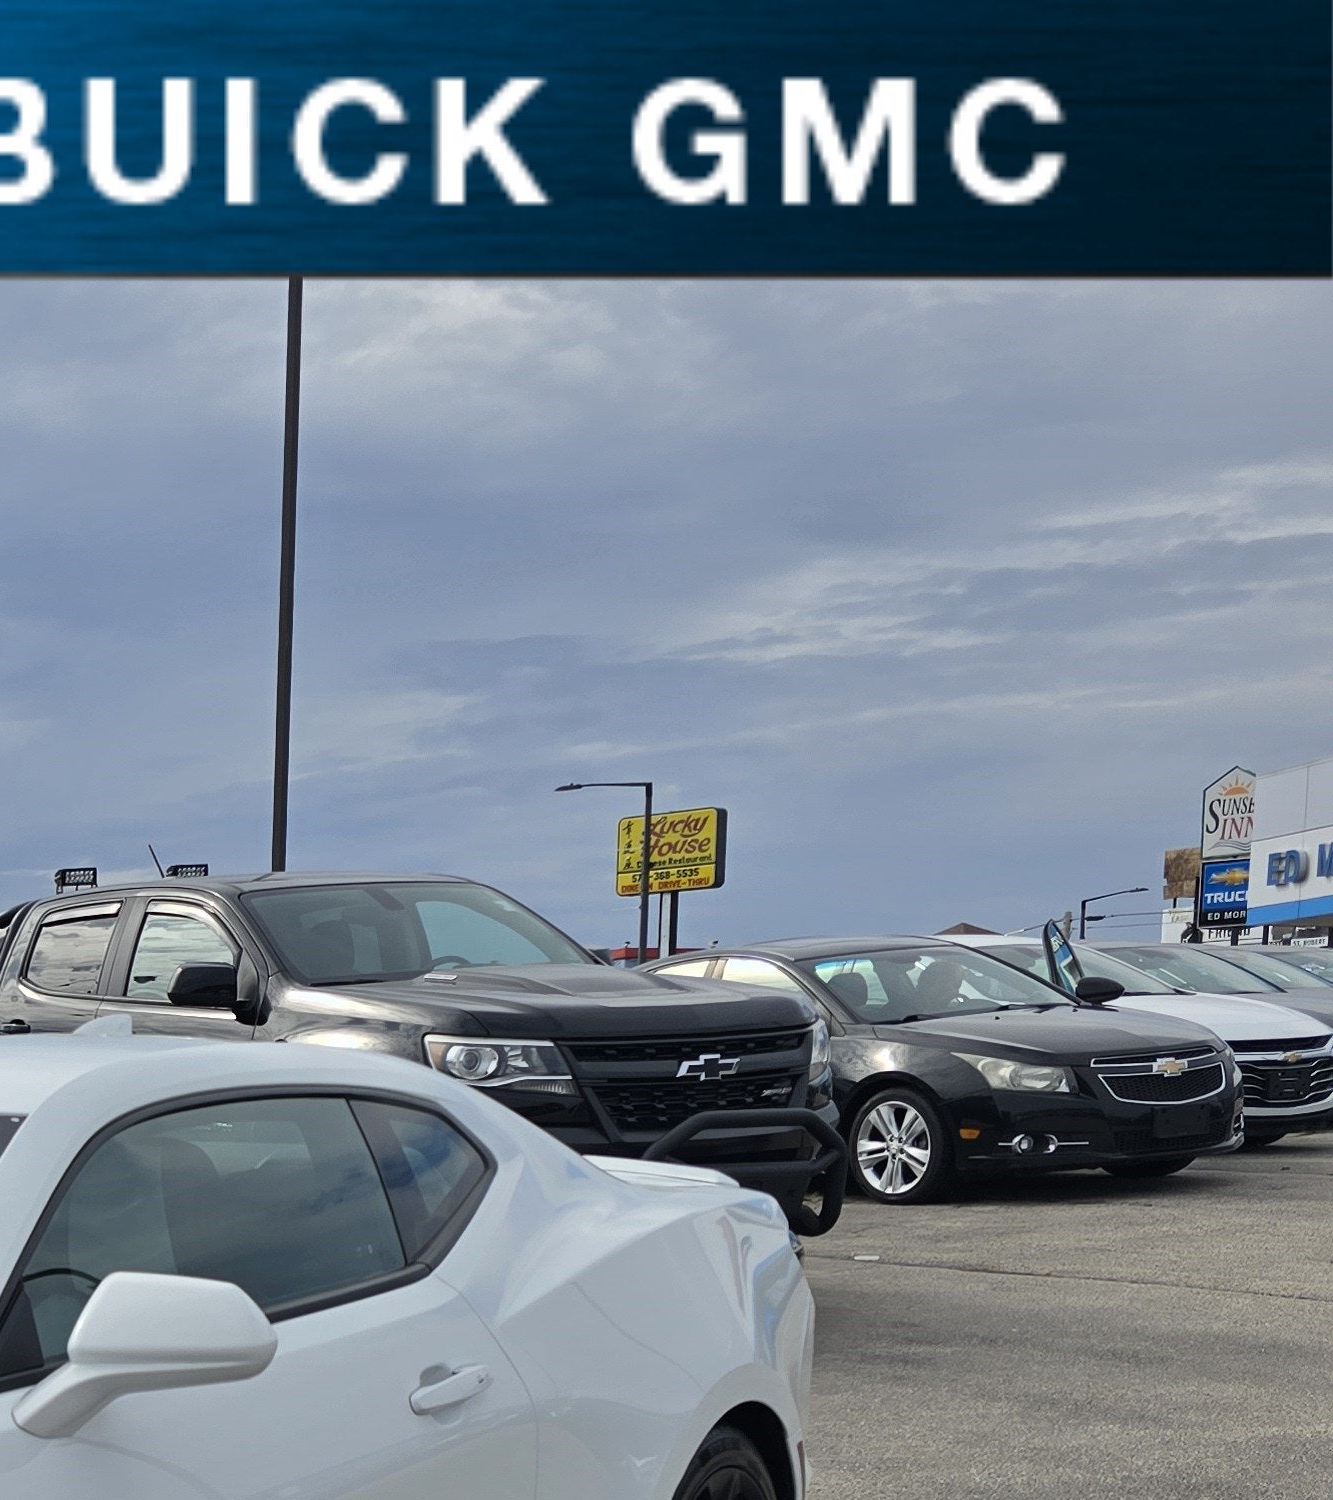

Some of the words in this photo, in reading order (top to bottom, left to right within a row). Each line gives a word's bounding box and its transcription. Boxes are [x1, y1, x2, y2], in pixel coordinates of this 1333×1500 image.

[650, 814, 710, 838] Lucky
[668, 853, 712, 864] Restaurant
[632, 868, 700, 882] 57-368-5535
[1266, 849, 1302, 887] ED
[1207, 912, 1220, 921] ED
